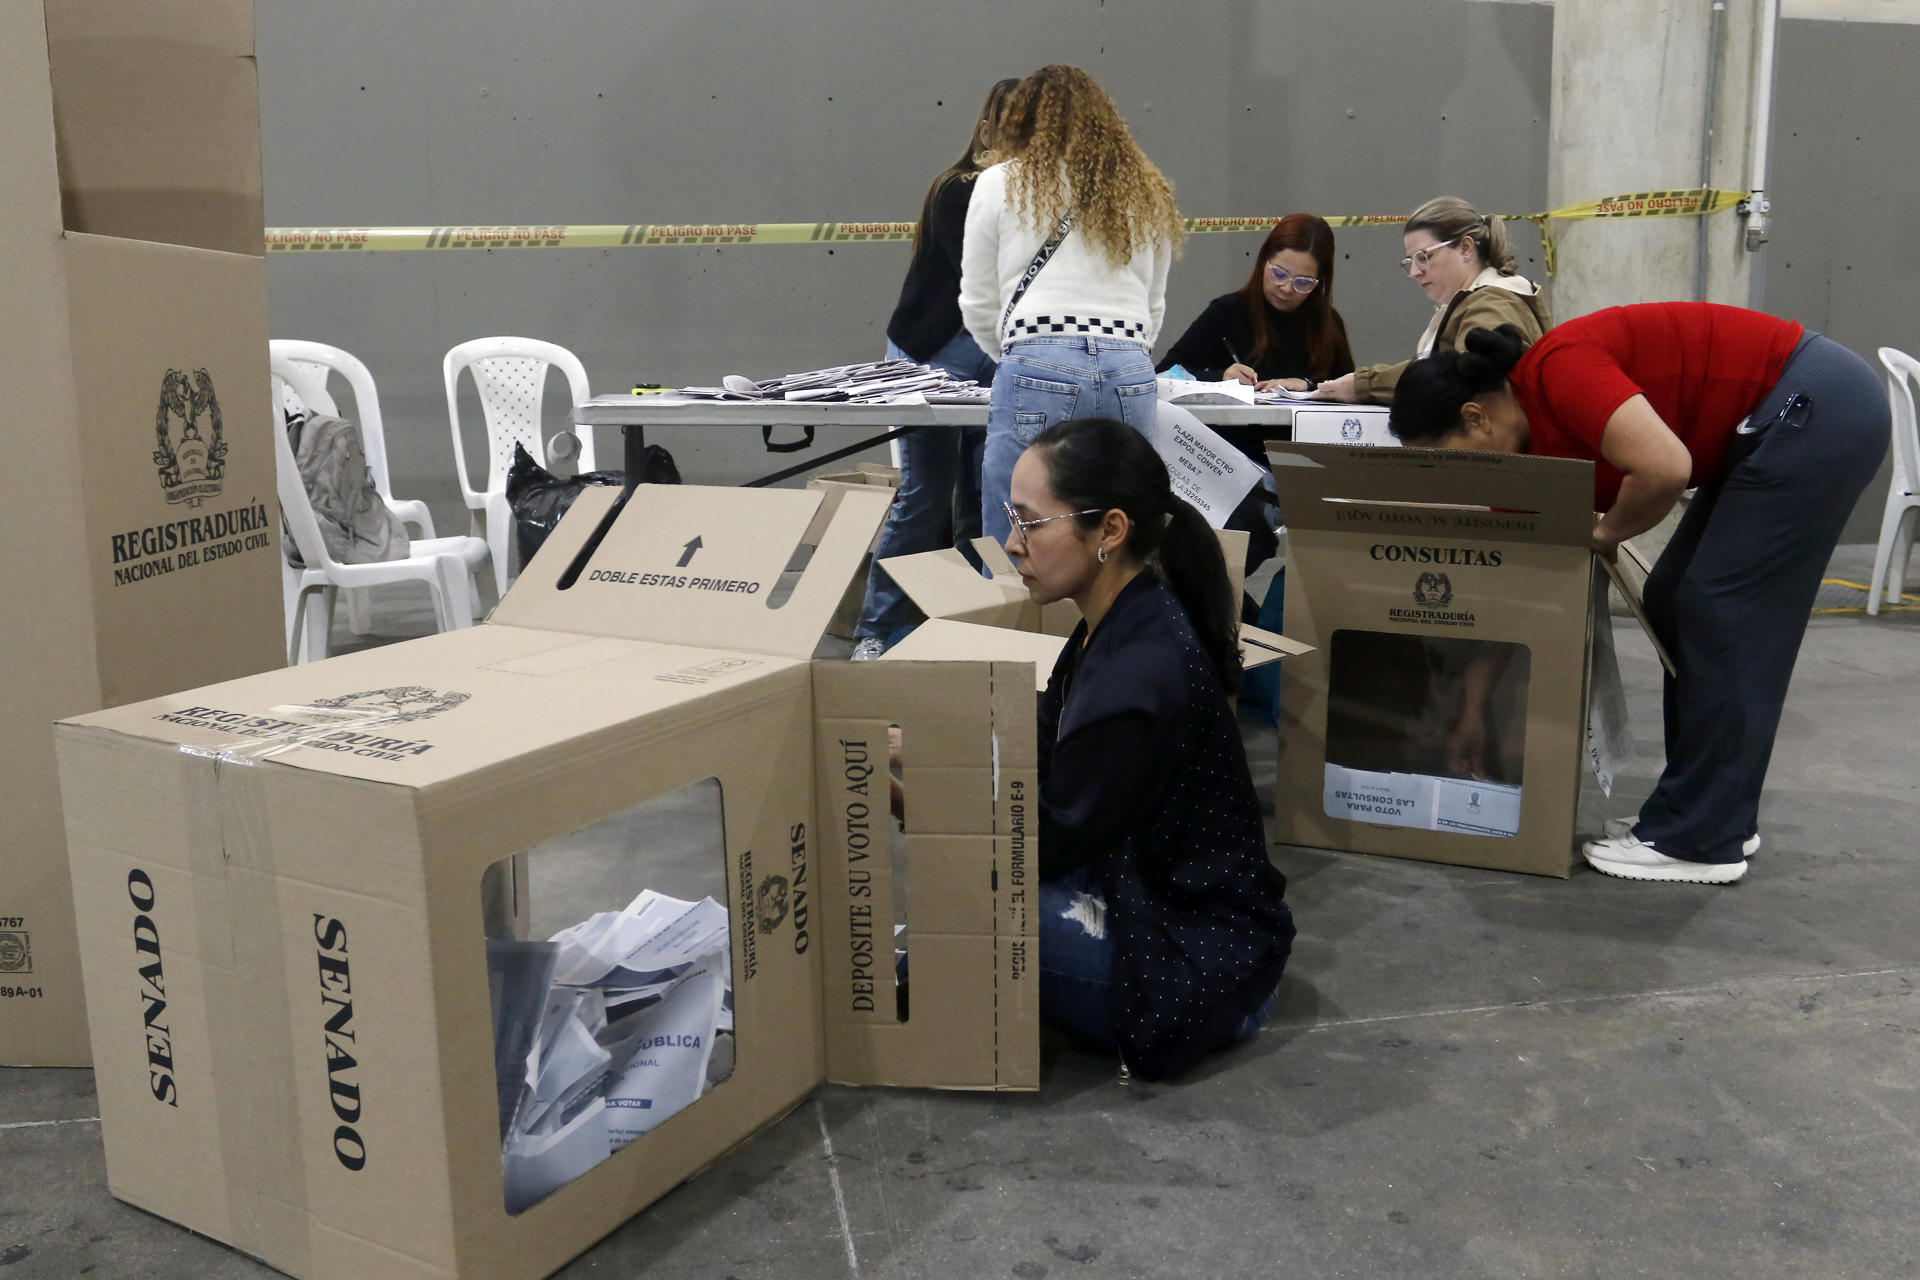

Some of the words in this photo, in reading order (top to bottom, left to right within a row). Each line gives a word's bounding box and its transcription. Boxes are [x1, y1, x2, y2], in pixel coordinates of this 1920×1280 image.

[1597, 201, 1624, 213] PASE
[1628, 199, 1644, 210] NO
[1648, 196, 1698, 208] PELIGRO
[651, 227, 702, 238] PELIGRO
[706, 226, 724, 237] NO
[727, 225, 757, 236] PASE
[841, 223, 890, 234] PELIGRO
[894, 223, 910, 233] NO
[1199, 217, 1245, 227] PELIGRO
[1248, 217, 1264, 226] NO
[264, 231, 307, 243] ELIGRO
[315, 232, 332, 243] NO
[336, 231, 368, 243] PASE
[456, 230, 509, 242] PELIGRO
[513, 229, 531, 241] NO
[534, 228, 566, 240] PASE
[1016, 256, 1045, 293] LOLA
[1173, 424, 1194, 443] PLAZA
[1193, 440, 1217, 461] MAYOR
[1215, 457, 1234, 474] CTRO
[1174, 435, 1196, 455] EXPOS
[1196, 453, 1223, 476] CONVEN
[1178, 456, 1198, 473] MESA
[1191, 483, 1202, 494] DE
[1379, 511, 1423, 525] VOTO
[1454, 516, 1535, 531] DEPOSITE
[112, 496, 269, 564] REGISTRADURÍA
[114, 556, 175, 587] NACIONAL
[178, 550, 200, 569] DEL
[203, 539, 243, 562] ESTADO
[245, 532, 270, 551] CIVIL
[1370, 544, 1503, 568] CONSULTAS
[588, 569, 639, 584] DOBLE
[639, 573, 688, 588] ESTAS
[688, 577, 760, 594] PRIMERO
[1389, 608, 1476, 622] REGISTRADURÍA
[152, 714, 238, 733] NACIONAL
[353, 748, 405, 762] CIVIL
[173, 706, 435, 755] REGISTDURÍA
[839, 739, 874, 797] AQUÍ
[1010, 781, 1024, 801] E-9
[1335, 790, 1395, 807] CONSULTAS
[1347, 802, 1372, 813] PARA
[1375, 805, 1401, 817] VOTO
[1397, 798, 1415, 808] LAS
[846, 801, 871, 864] VOTO
[1011, 804, 1025, 887] FORMULARIO
[790, 822, 809, 955] SENADO
[849, 869, 872, 898] SU
[743, 850, 759, 980] REGISTRADURÍA
[851, 903, 875, 1014] DEPOSITE
[128, 868, 178, 1109] SENADO
[313, 913, 366, 1172] SENADO
